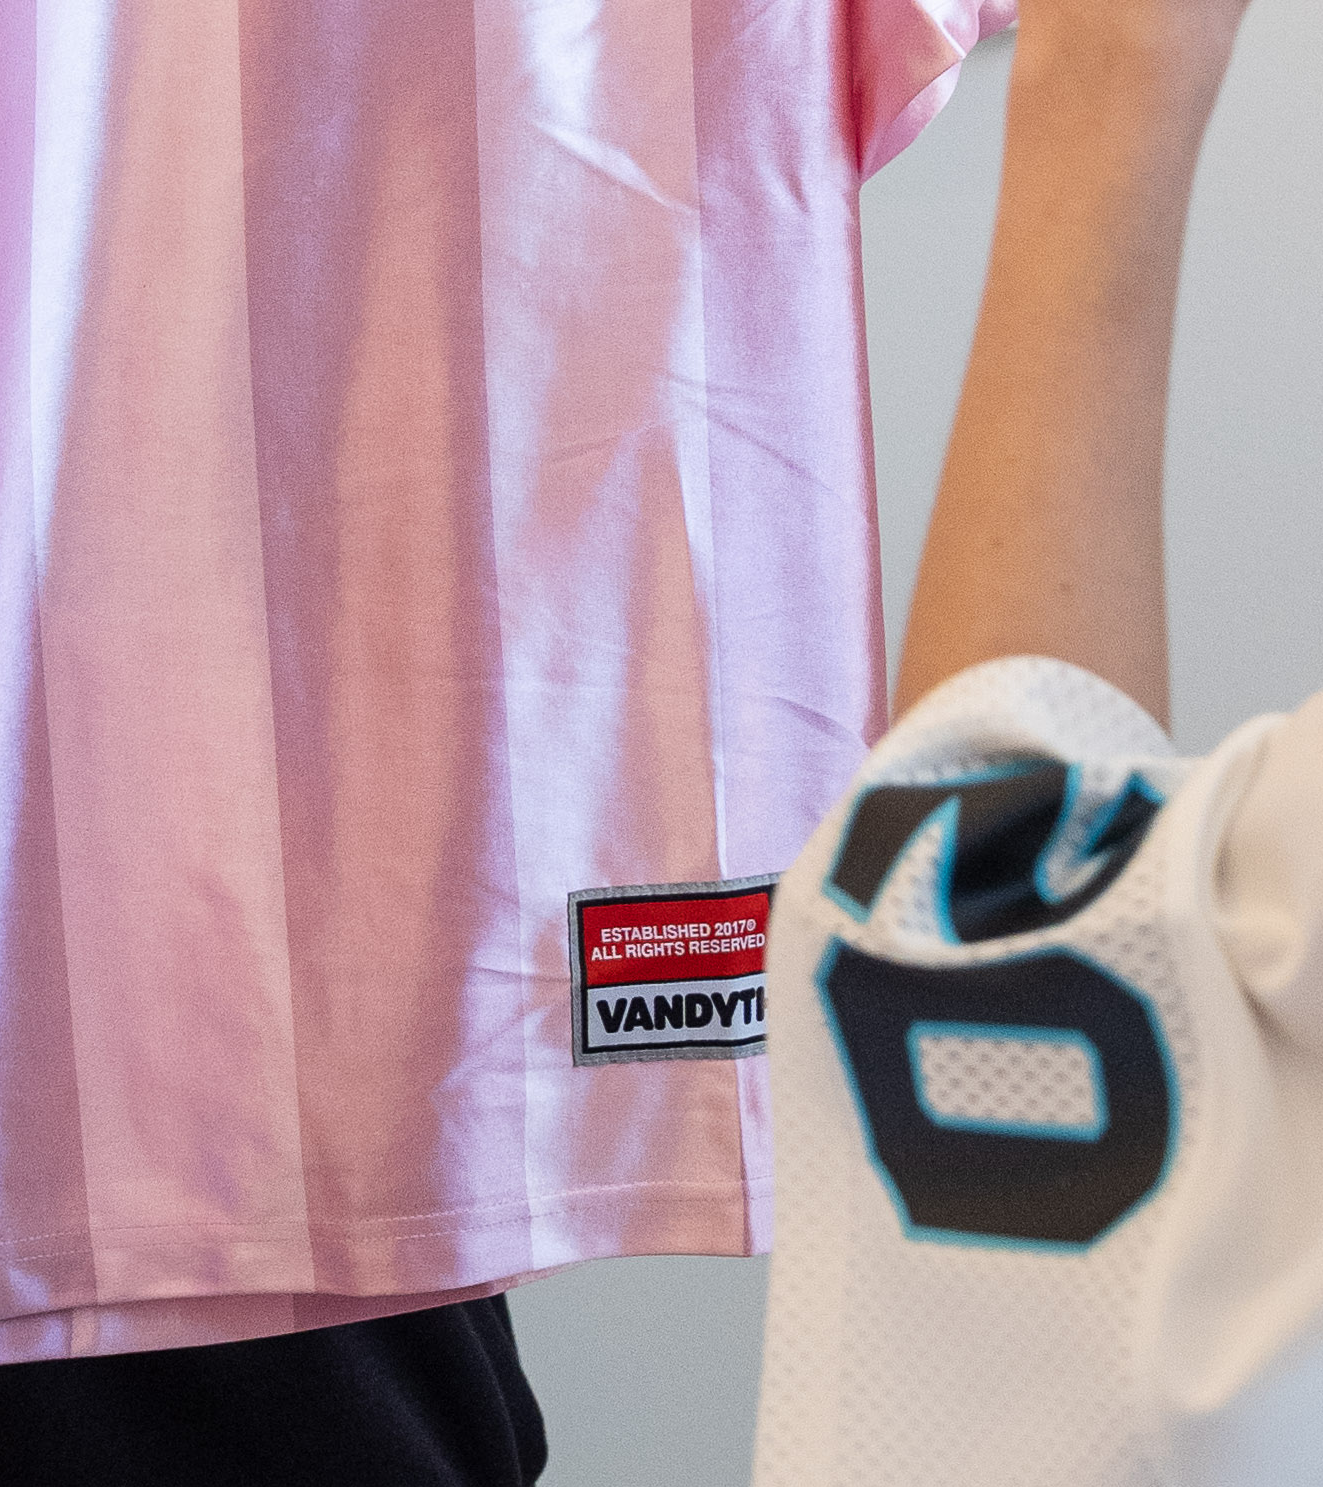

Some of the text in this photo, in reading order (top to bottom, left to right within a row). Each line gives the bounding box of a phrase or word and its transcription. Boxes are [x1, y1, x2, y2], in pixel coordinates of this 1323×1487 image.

[600, 922, 711, 943] ESTABLISHED
[591, 934, 766, 962] ALL RIGHTS RESERVED
